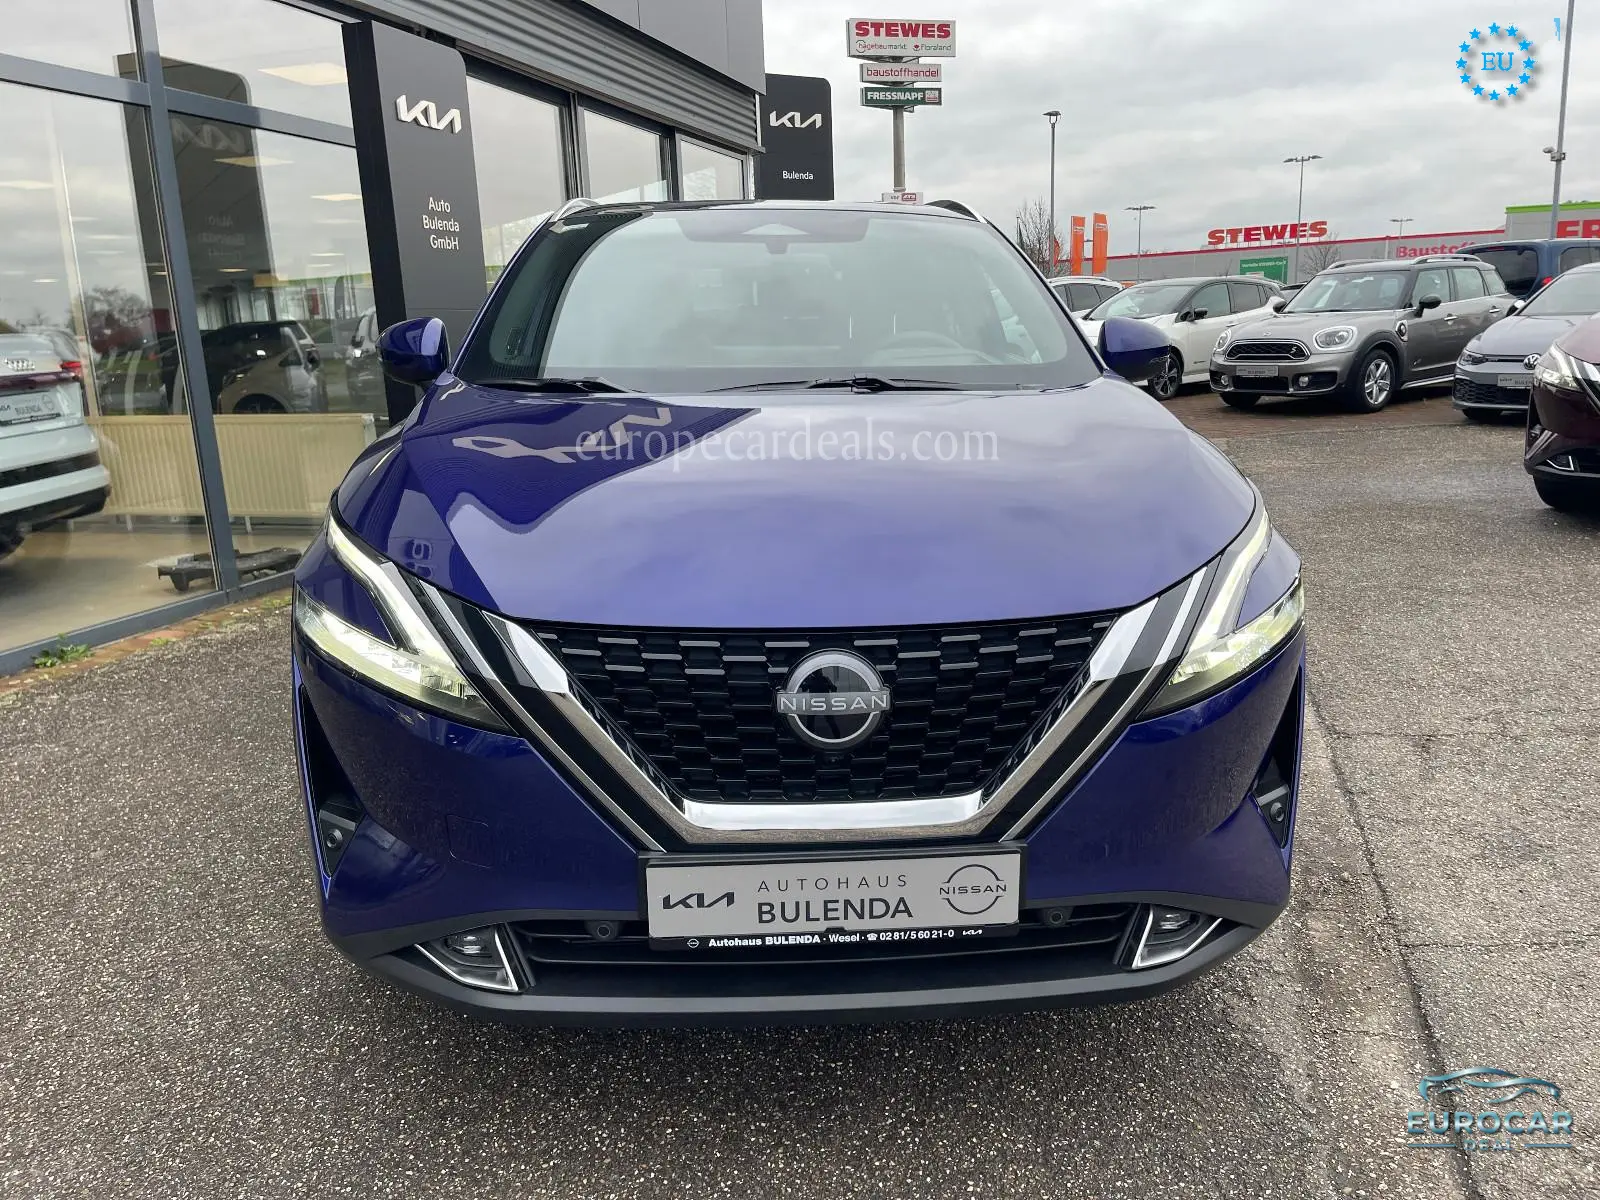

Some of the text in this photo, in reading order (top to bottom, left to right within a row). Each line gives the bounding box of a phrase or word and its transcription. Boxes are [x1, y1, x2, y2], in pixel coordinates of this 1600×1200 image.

[855, 21, 951, 38] STEWES
[866, 67, 939, 78] baustoffhandel
[867, 91, 924, 101] FRESSNAPF
[395, 94, 462, 134] KIA
[769, 111, 822, 129] KIA
[782, 171, 814, 180] Bulenda
[428, 197, 451, 213] Auto
[422, 215, 460, 232] Bulenda
[1207, 220, 1328, 246] STEWES
[430, 235, 459, 250] GmbH
[780, 695, 888, 711] NISSAN
[757, 875, 907, 893] AUTOHAUS
[939, 883, 1007, 896] NISSAN
[662, 891, 735, 910] KIA
[757, 897, 914, 924] BULENDA
[708, 938, 762, 947] Autohaus
[765, 934, 821, 945] BULENDA
[828, 933, 860, 943] Wesel
